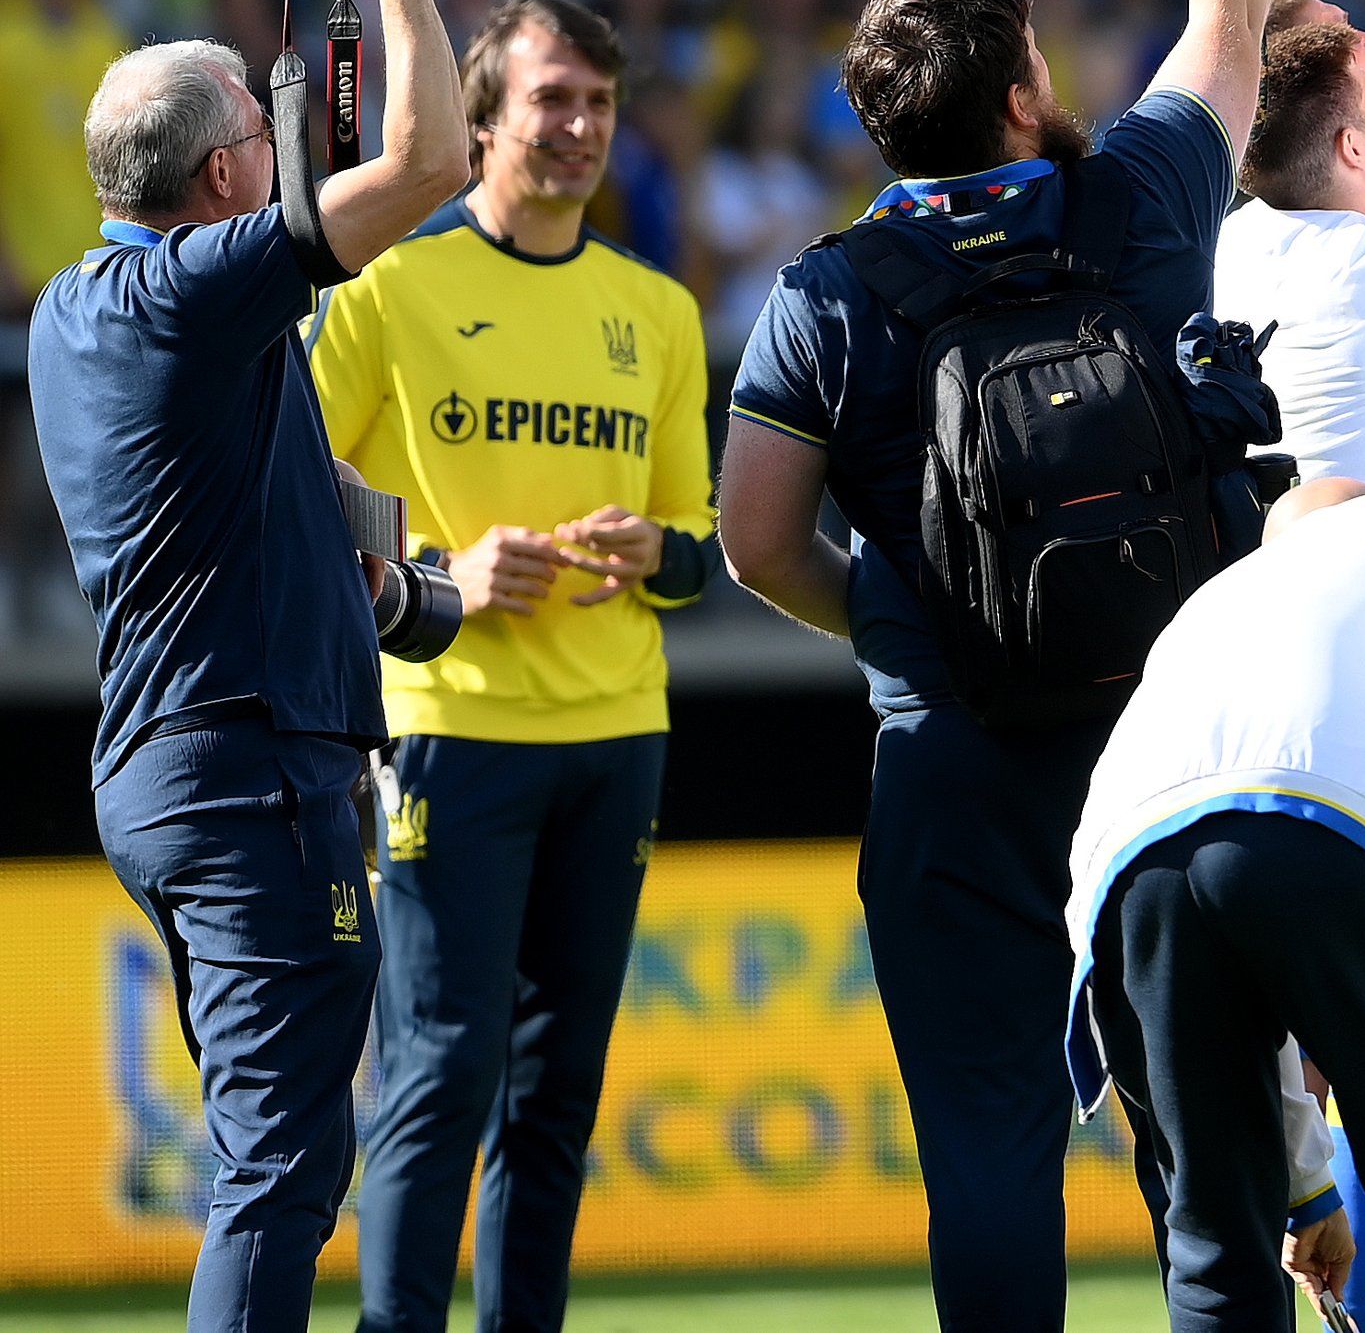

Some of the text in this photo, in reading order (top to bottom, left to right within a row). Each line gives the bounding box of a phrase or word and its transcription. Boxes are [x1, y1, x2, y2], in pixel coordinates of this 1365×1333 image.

[337, 61, 354, 143] Canon
[952, 230, 1007, 251] UKRAINE
[486, 398, 649, 458] EPICENTR
